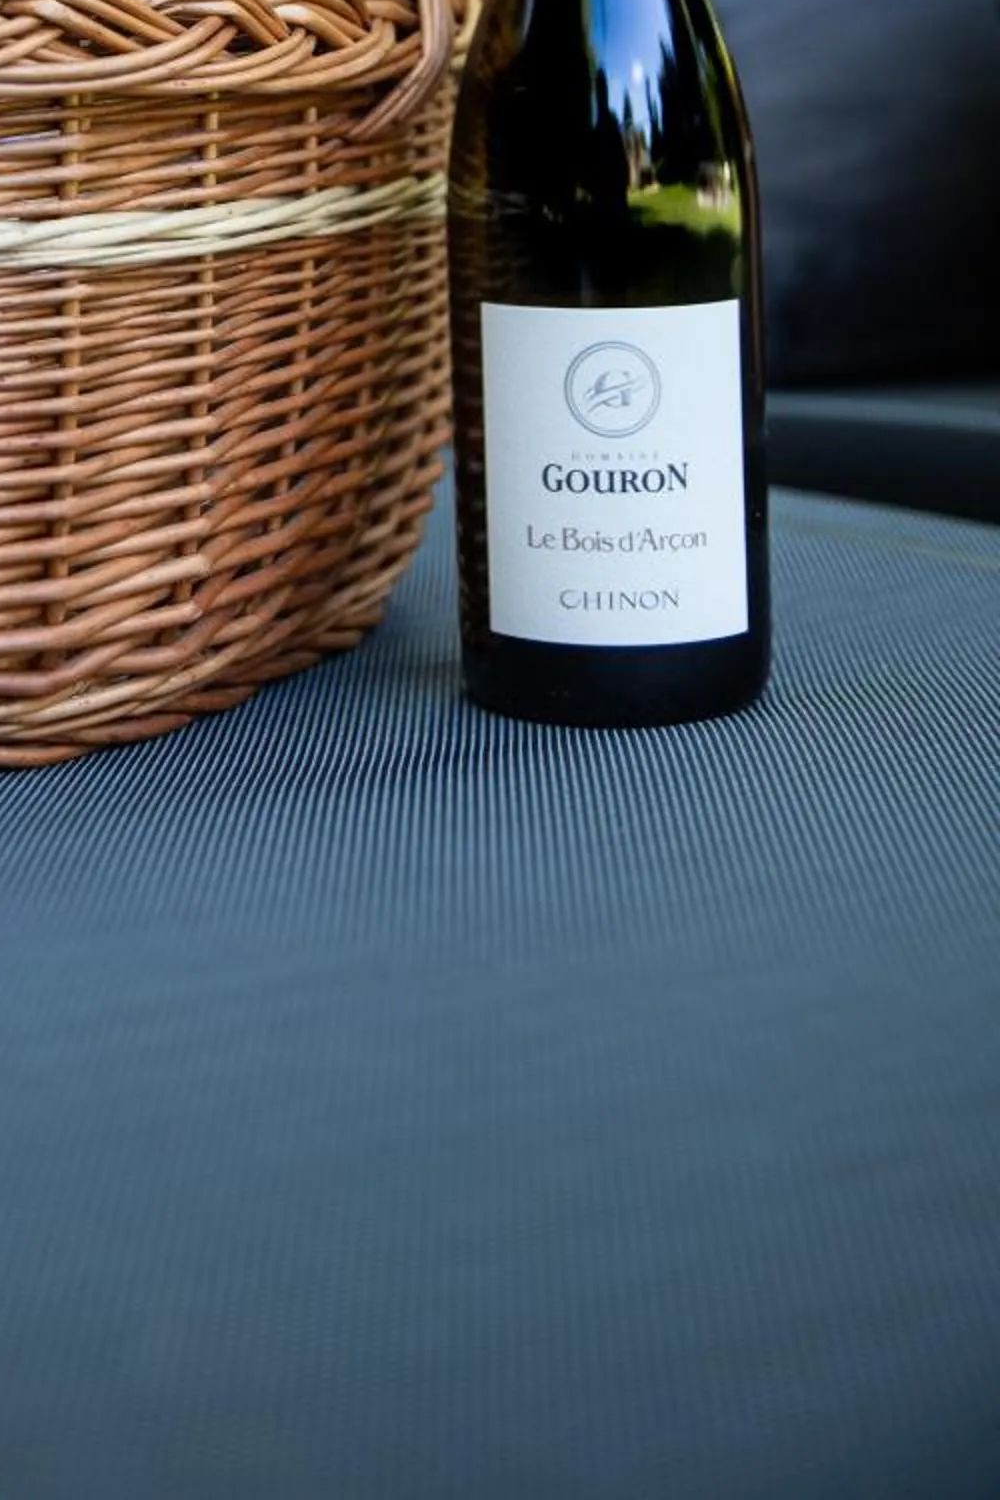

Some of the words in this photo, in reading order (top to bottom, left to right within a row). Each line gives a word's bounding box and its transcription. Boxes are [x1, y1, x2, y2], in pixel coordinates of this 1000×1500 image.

[541, 462, 690, 495] GOURON
[526, 525, 556, 551] Le
[562, 527, 615, 553] Bois
[559, 588, 680, 611] CHINON
